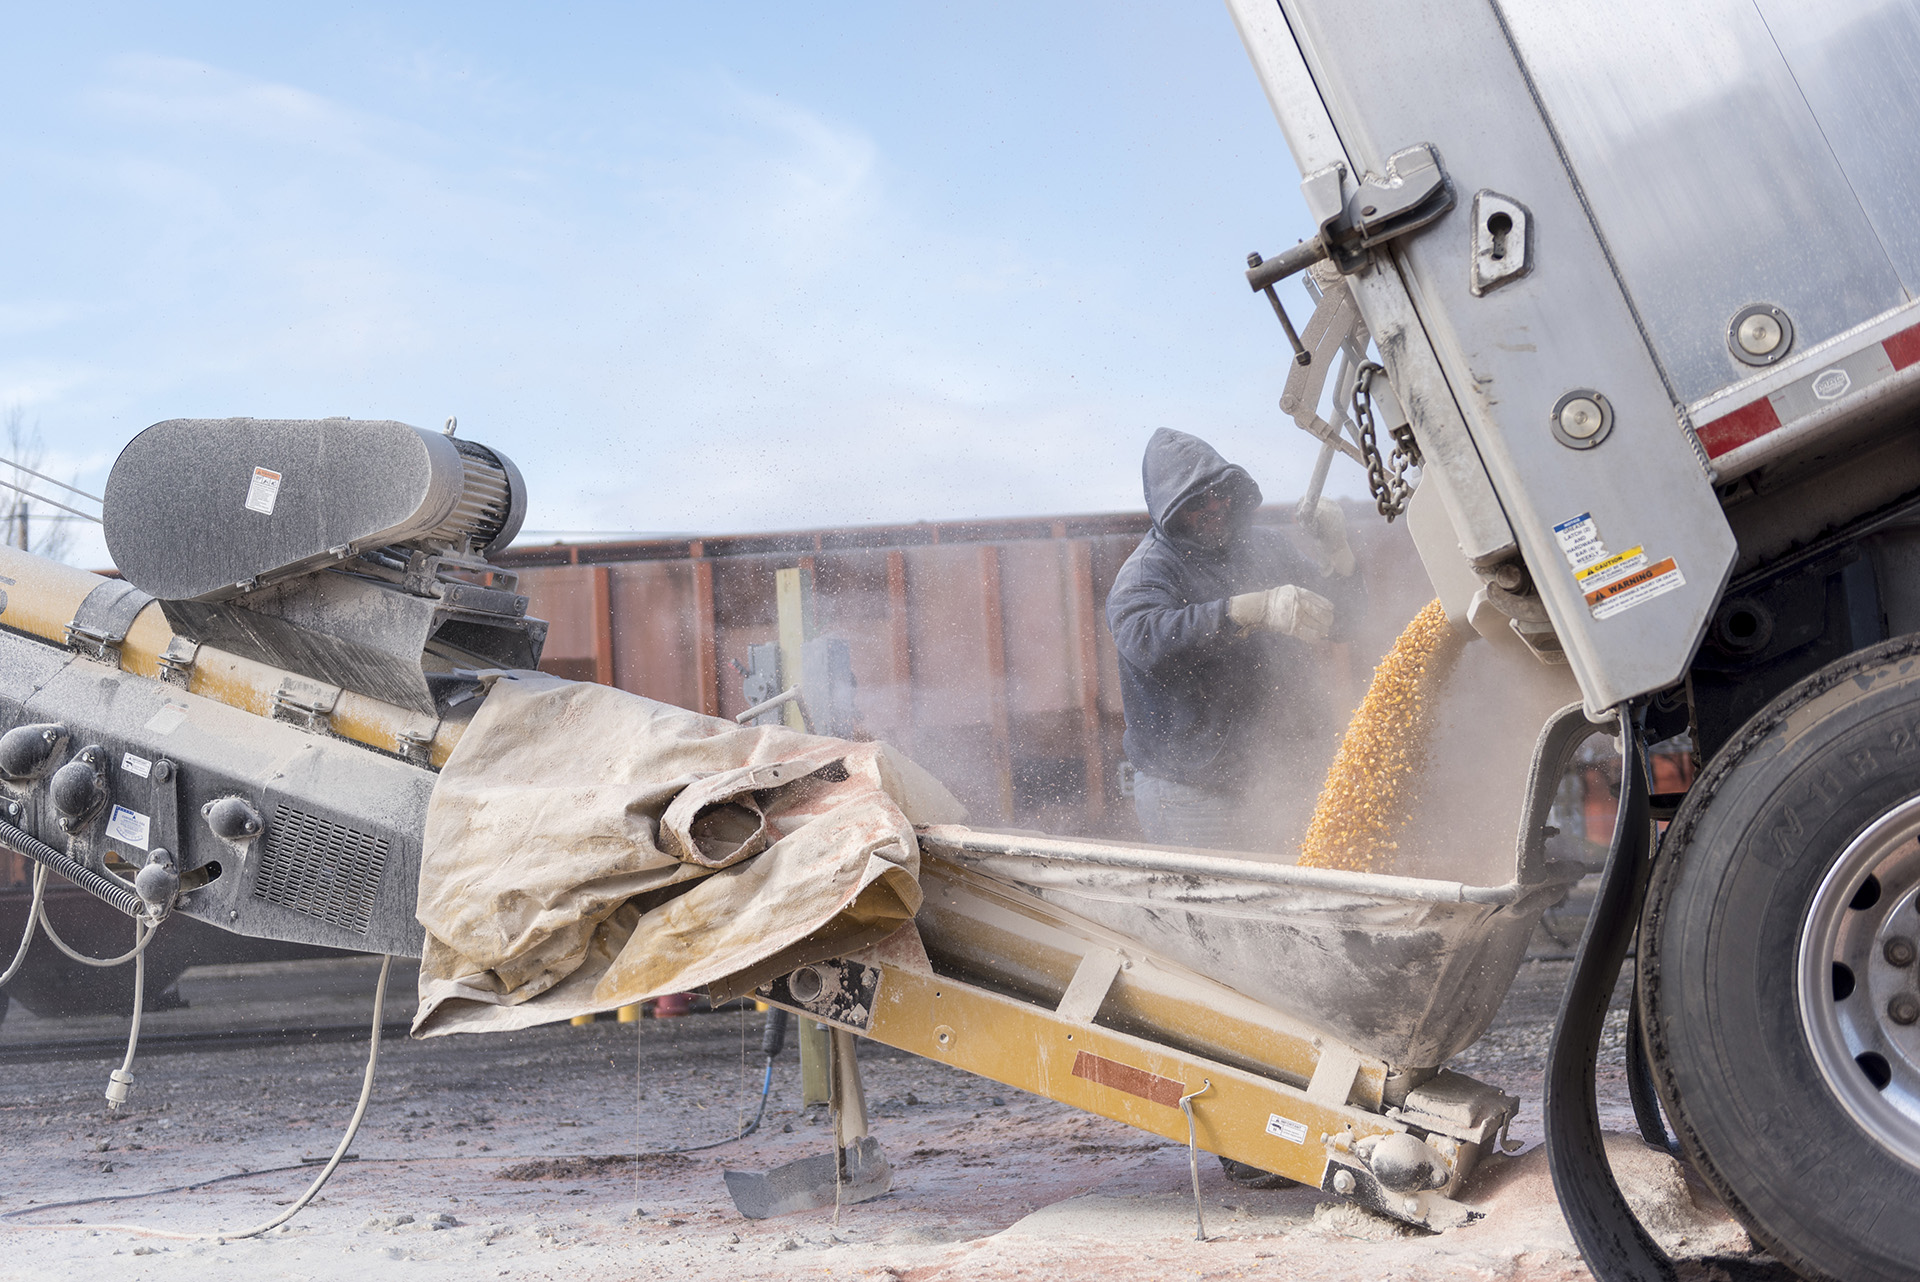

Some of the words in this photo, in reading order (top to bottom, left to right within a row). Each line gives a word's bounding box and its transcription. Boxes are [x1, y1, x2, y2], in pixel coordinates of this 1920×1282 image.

[1563, 521, 1585, 534] GREASE
[1563, 530, 1583, 542] LATCH
[1573, 535, 1587, 544] AND
[1566, 536, 1598, 554] HARDWARE
[1575, 549, 1587, 558] BAR
[1576, 551, 1599, 564] WEEKLY
[1594, 555, 1624, 571] CAUTION
[1608, 570, 1653, 594] WARNING
[1808, 770, 1844, 805] 11
